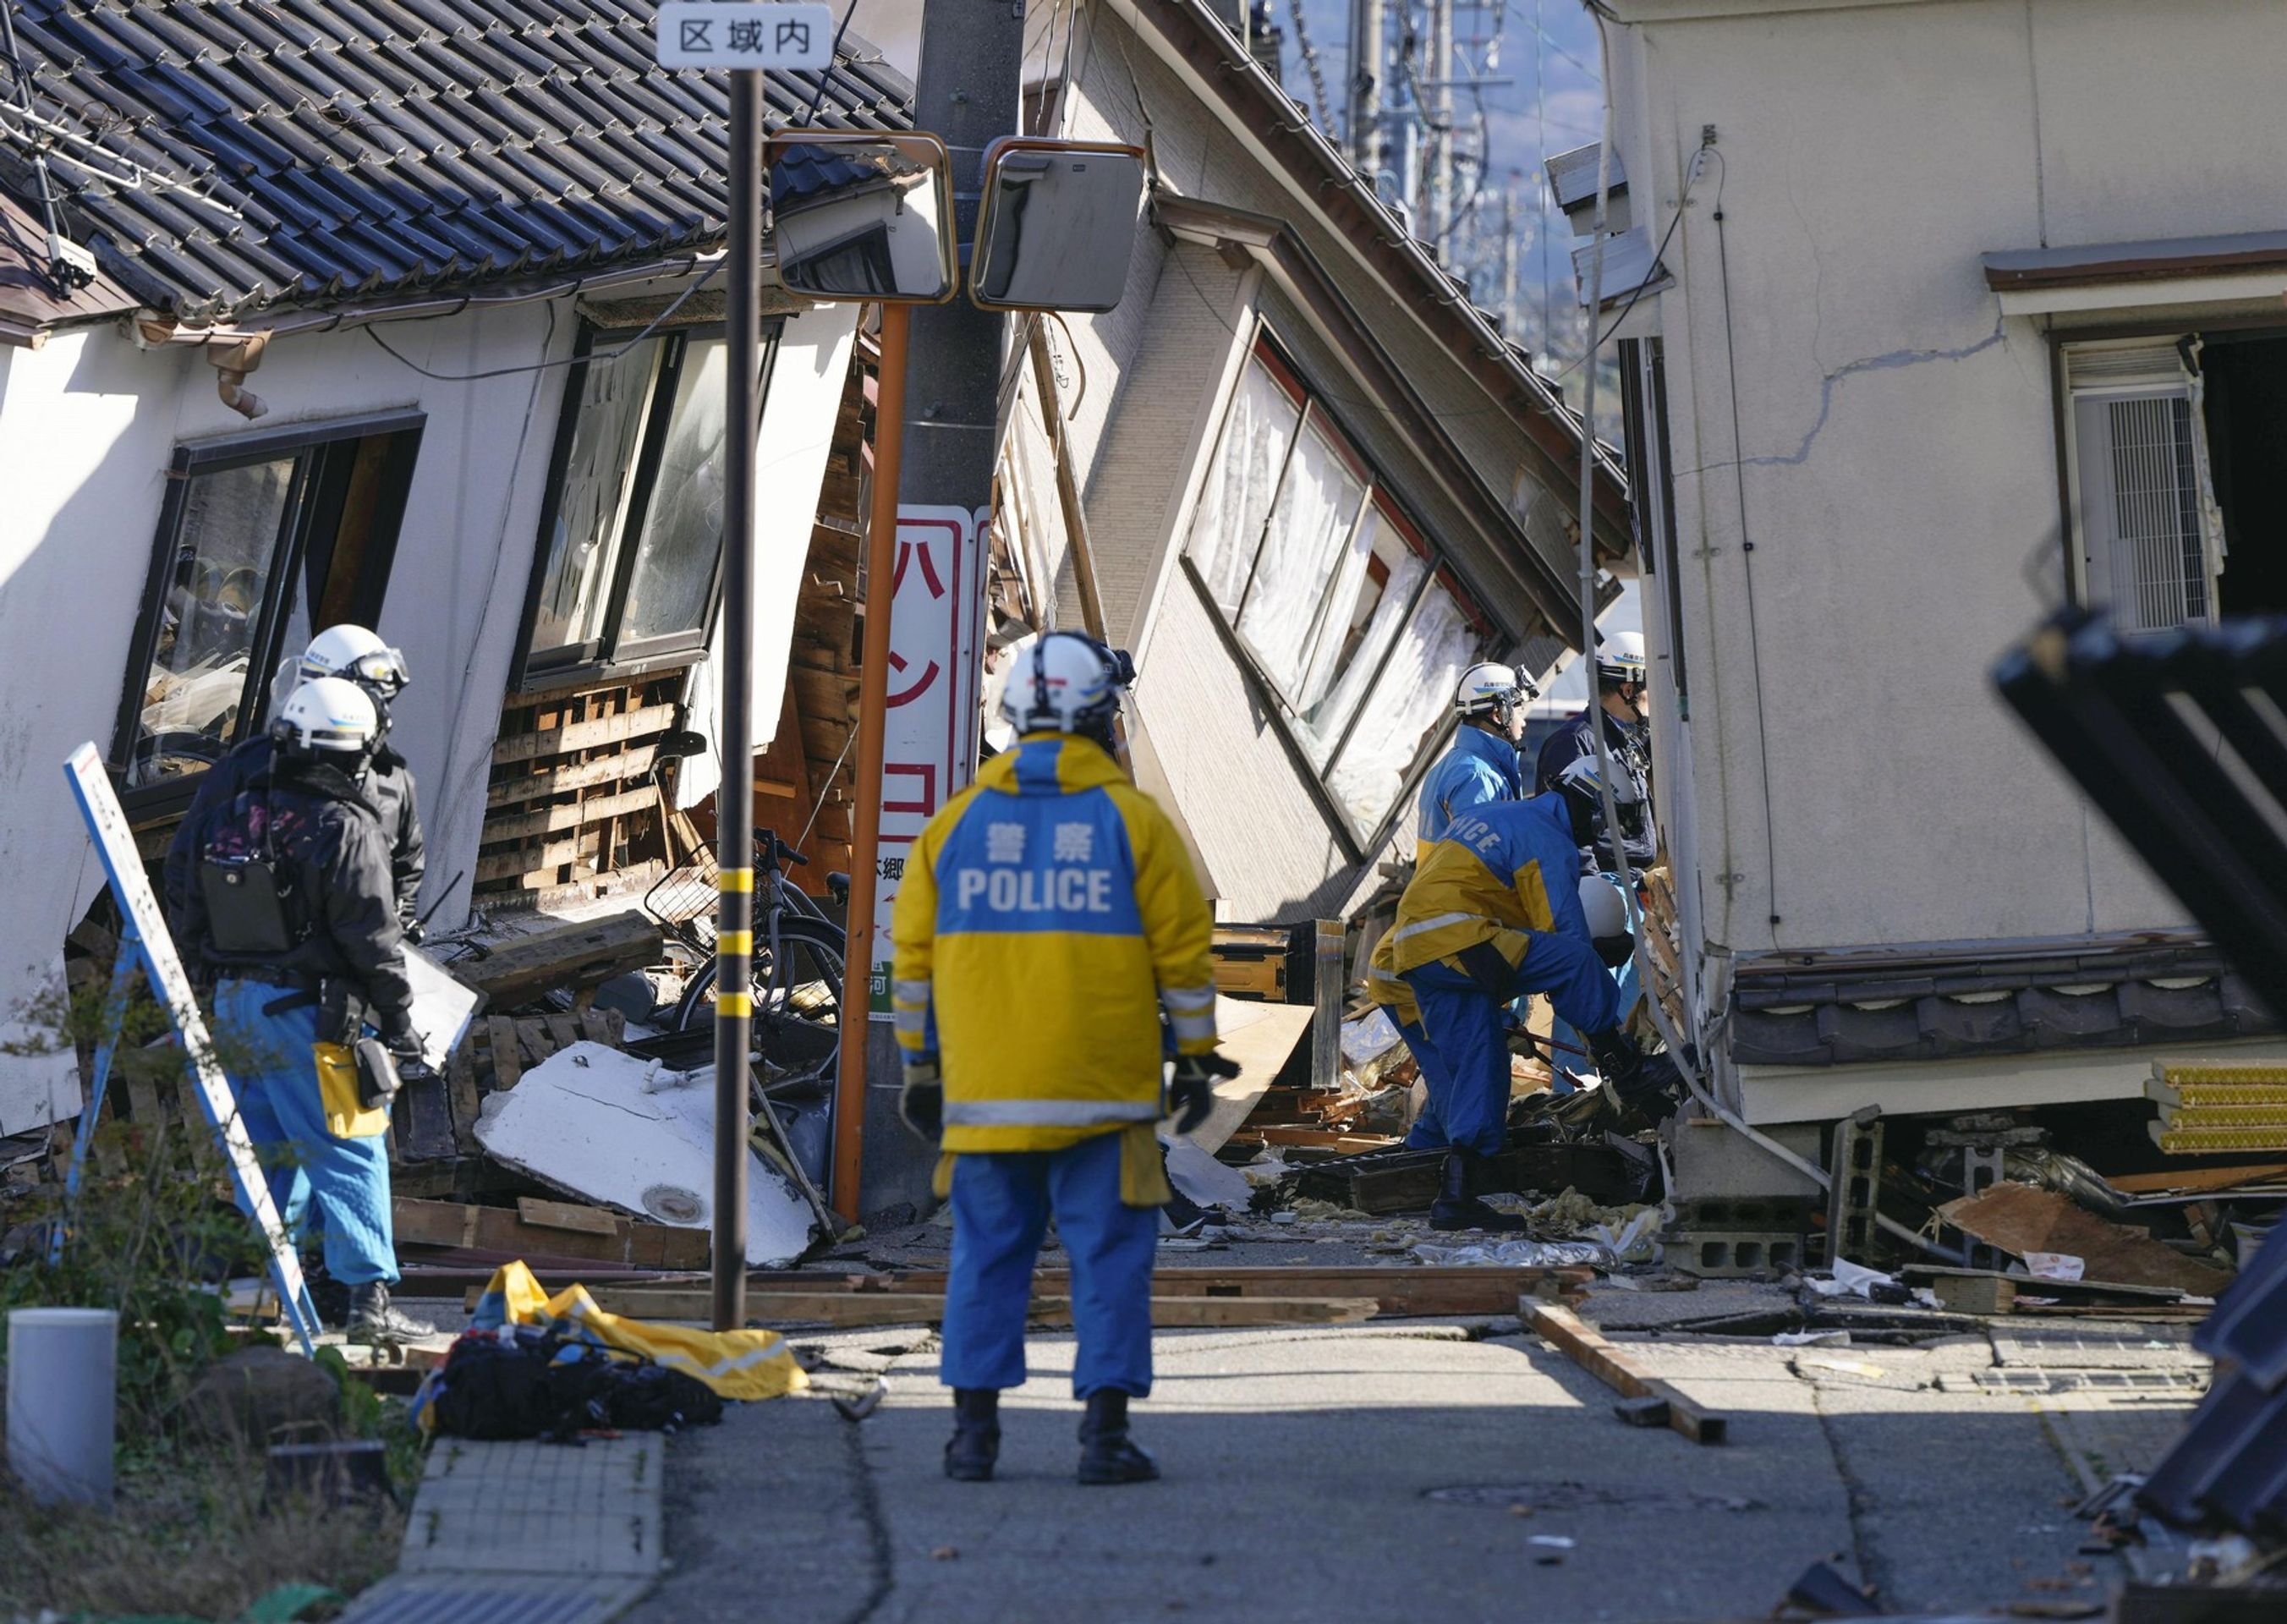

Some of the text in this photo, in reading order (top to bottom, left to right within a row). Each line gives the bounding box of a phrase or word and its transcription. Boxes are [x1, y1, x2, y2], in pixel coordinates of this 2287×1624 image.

[679, 18, 809, 54] 区域内
[883, 541, 946, 818] ハンコ
[986, 821, 1094, 863] 警察
[957, 868, 1112, 913] POLICE
